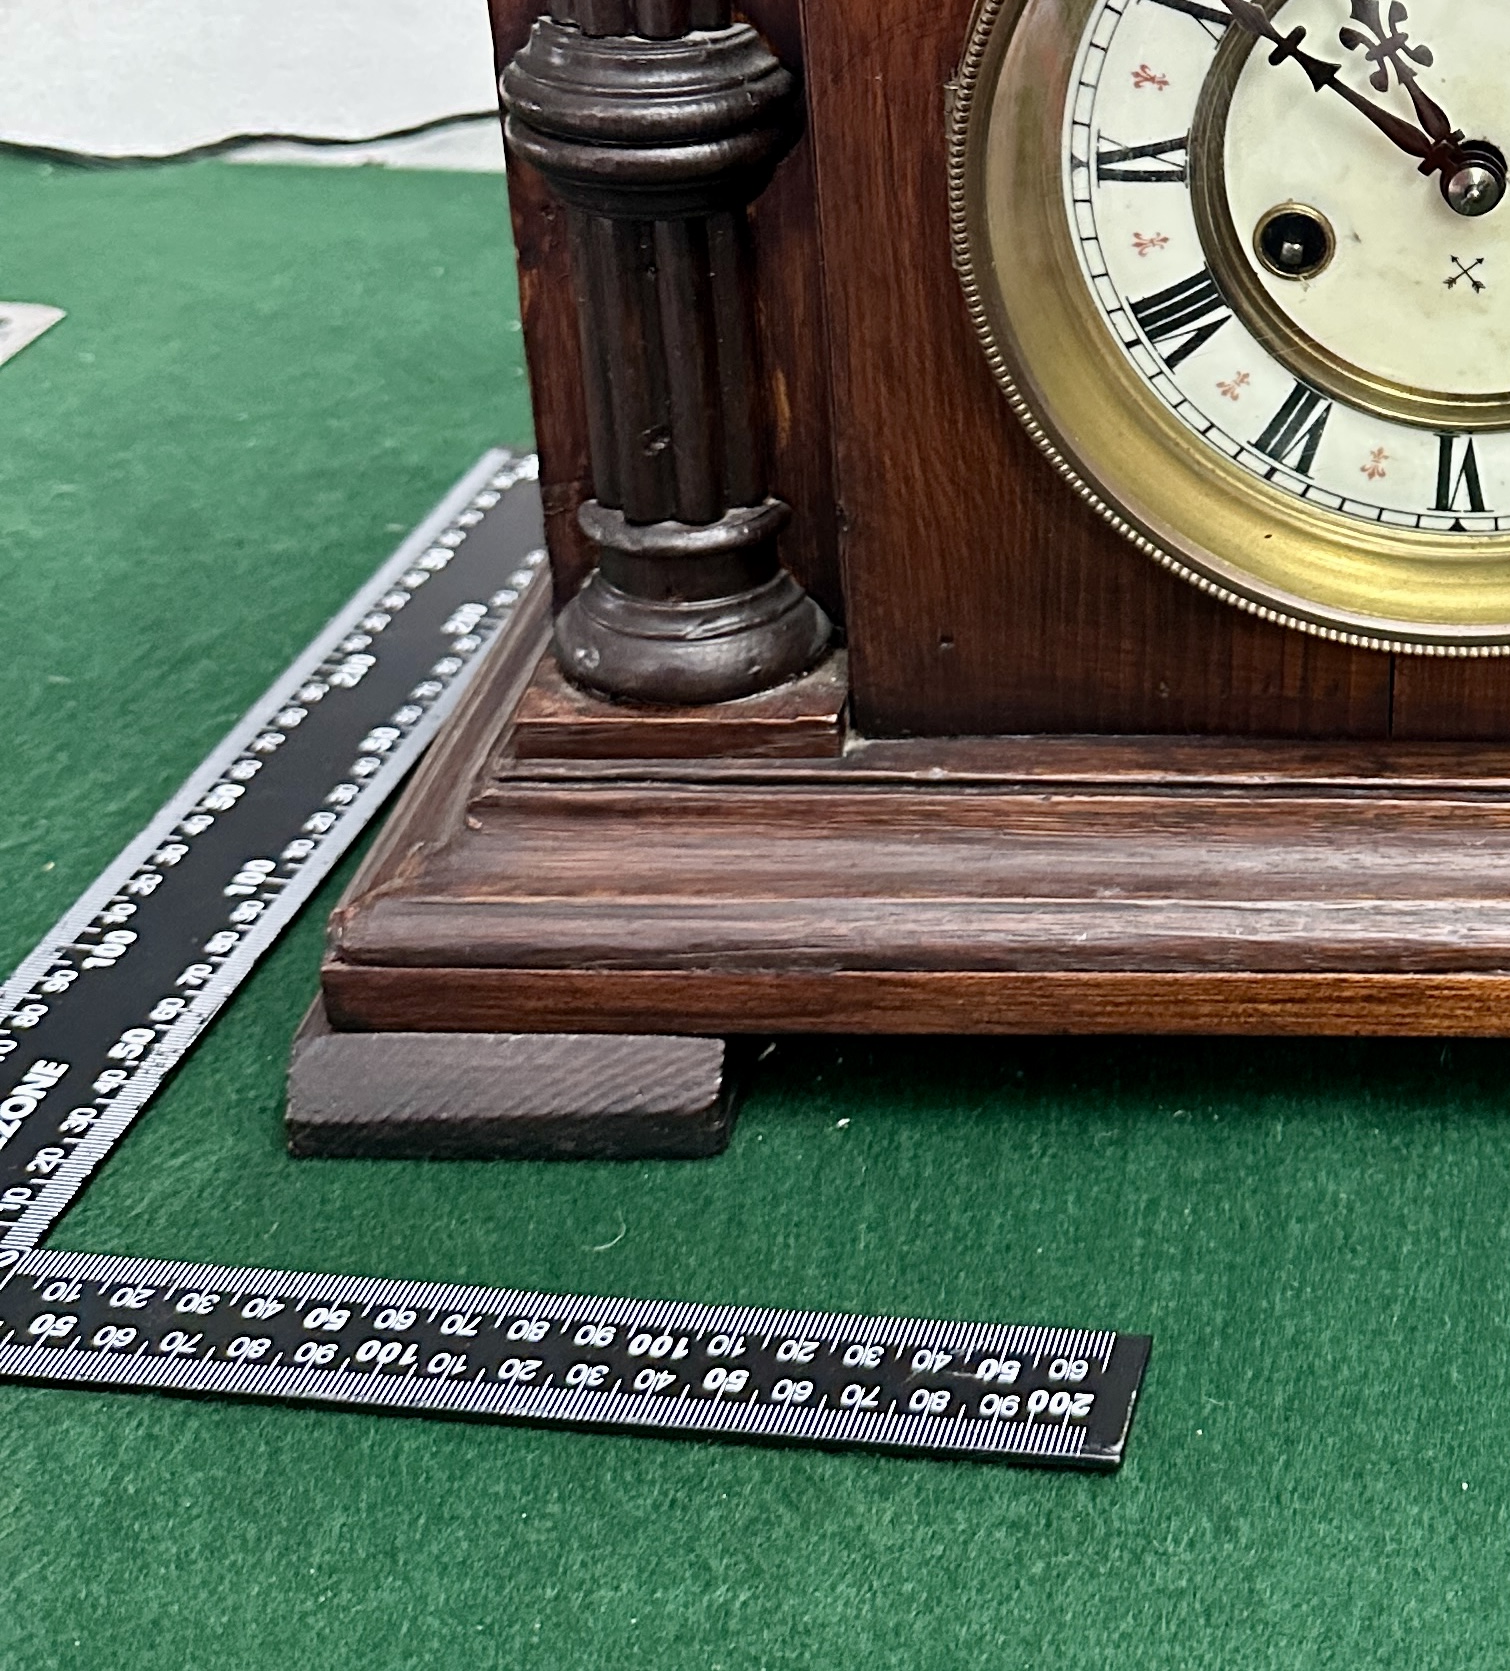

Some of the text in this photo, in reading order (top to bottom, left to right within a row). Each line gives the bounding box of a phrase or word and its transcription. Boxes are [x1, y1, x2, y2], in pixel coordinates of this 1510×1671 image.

[1096, 128, 1192, 189] IX
[1126, 260, 1232, 375] VIII
[1246, 378, 1333, 480] VII
[1427, 431, 1495, 513] VI
[440, 602, 488, 634] 200
[329, 654, 377, 688] 200
[358, 726, 401, 753] 50
[203, 783, 246, 811] 50
[302, 811, 337, 833] 20
[281, 838, 315, 860] 10
[127, 873, 164, 896] 20
[223, 859, 276, 897] 100
[101, 903, 137, 925] 10
[229, 900, 265, 923] 90
[82, 929, 138, 969] 100
[204, 930, 240, 954] 80
[41, 969, 79, 993] 90
[175, 963, 213, 986] 70
[10, 1003, 49, 1028] 80
[150, 997, 186, 1021] 60
[107, 1028, 156, 1059] 50
[91, 1069, 128, 1094] 40
[58, 1107, 97, 1133] 30
[25, 1147, 65, 1173] 20
[41, 1281, 1089, 1384] 60 50 40 30 20 10 100 90 80 70 60 50 40 30 20 10
[28, 1313, 1095, 1418] 200 90 80 70 60 50 40 30 20 10 100 90 80 70 60 50
